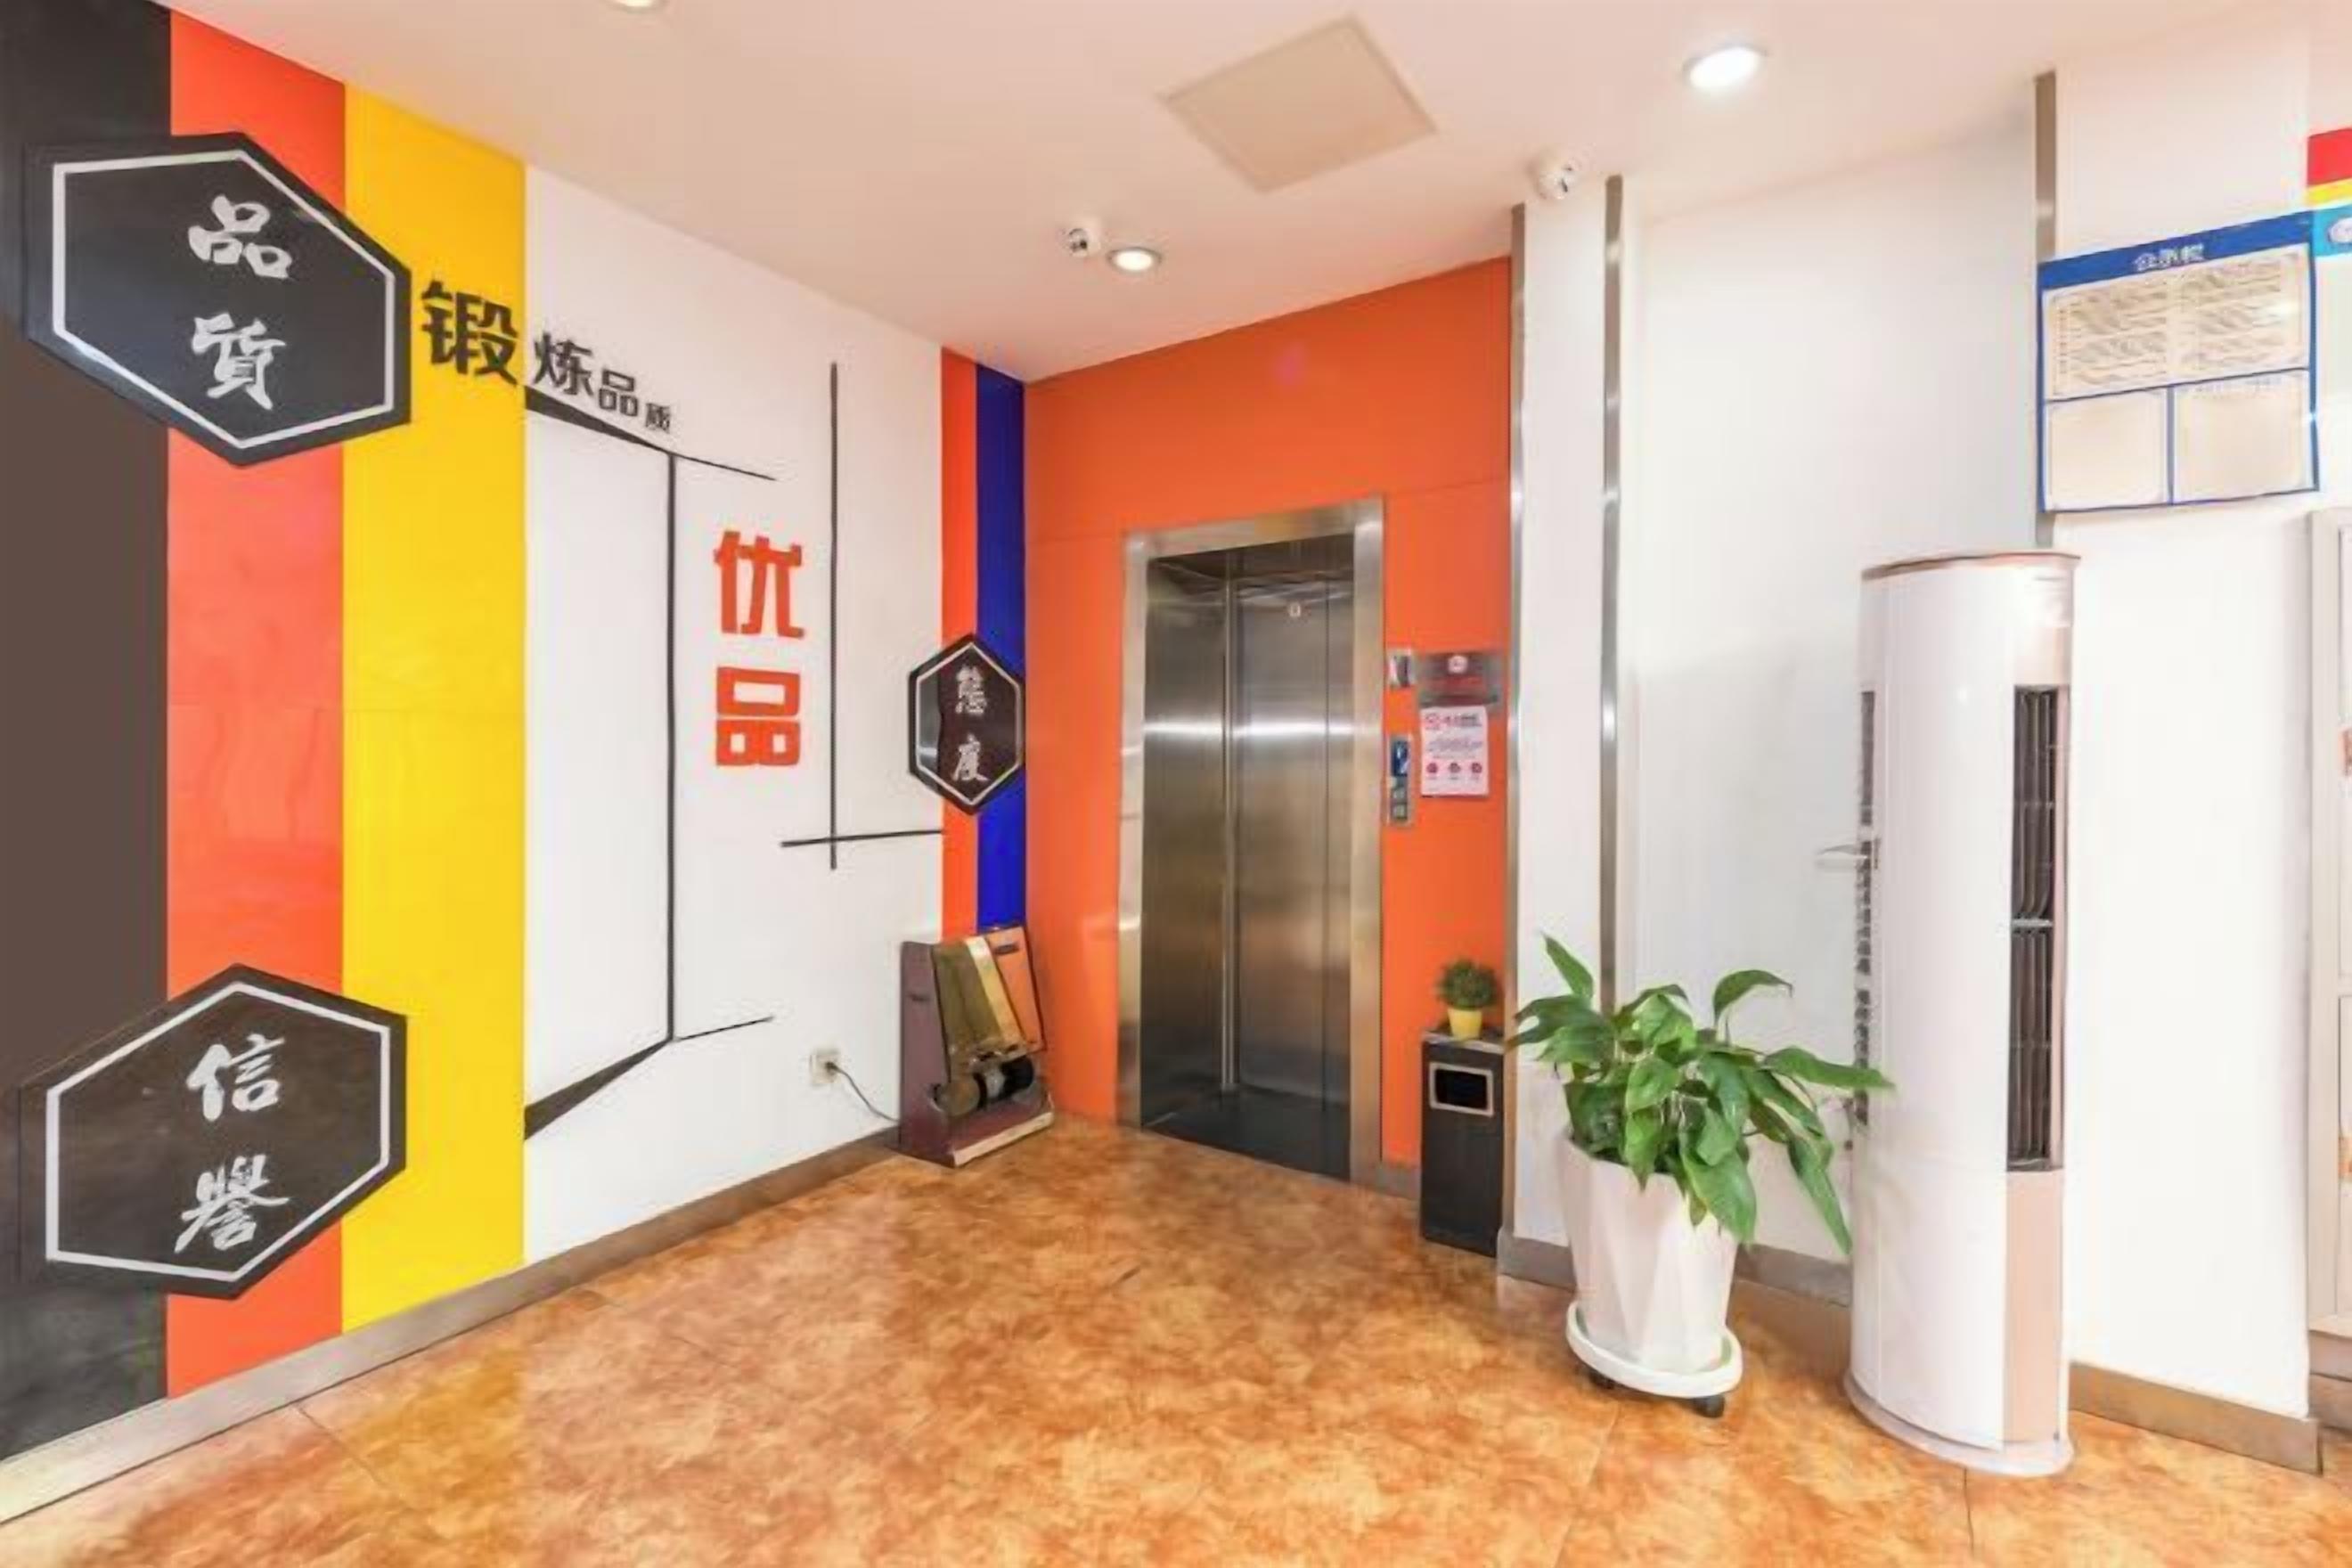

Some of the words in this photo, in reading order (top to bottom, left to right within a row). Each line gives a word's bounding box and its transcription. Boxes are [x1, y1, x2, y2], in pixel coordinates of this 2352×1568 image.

[188, 194, 293, 410] 品質
[421, 281, 670, 433] 锻炼品质
[714, 531, 804, 765] 优品
[175, 1033, 290, 1253] 信譽
